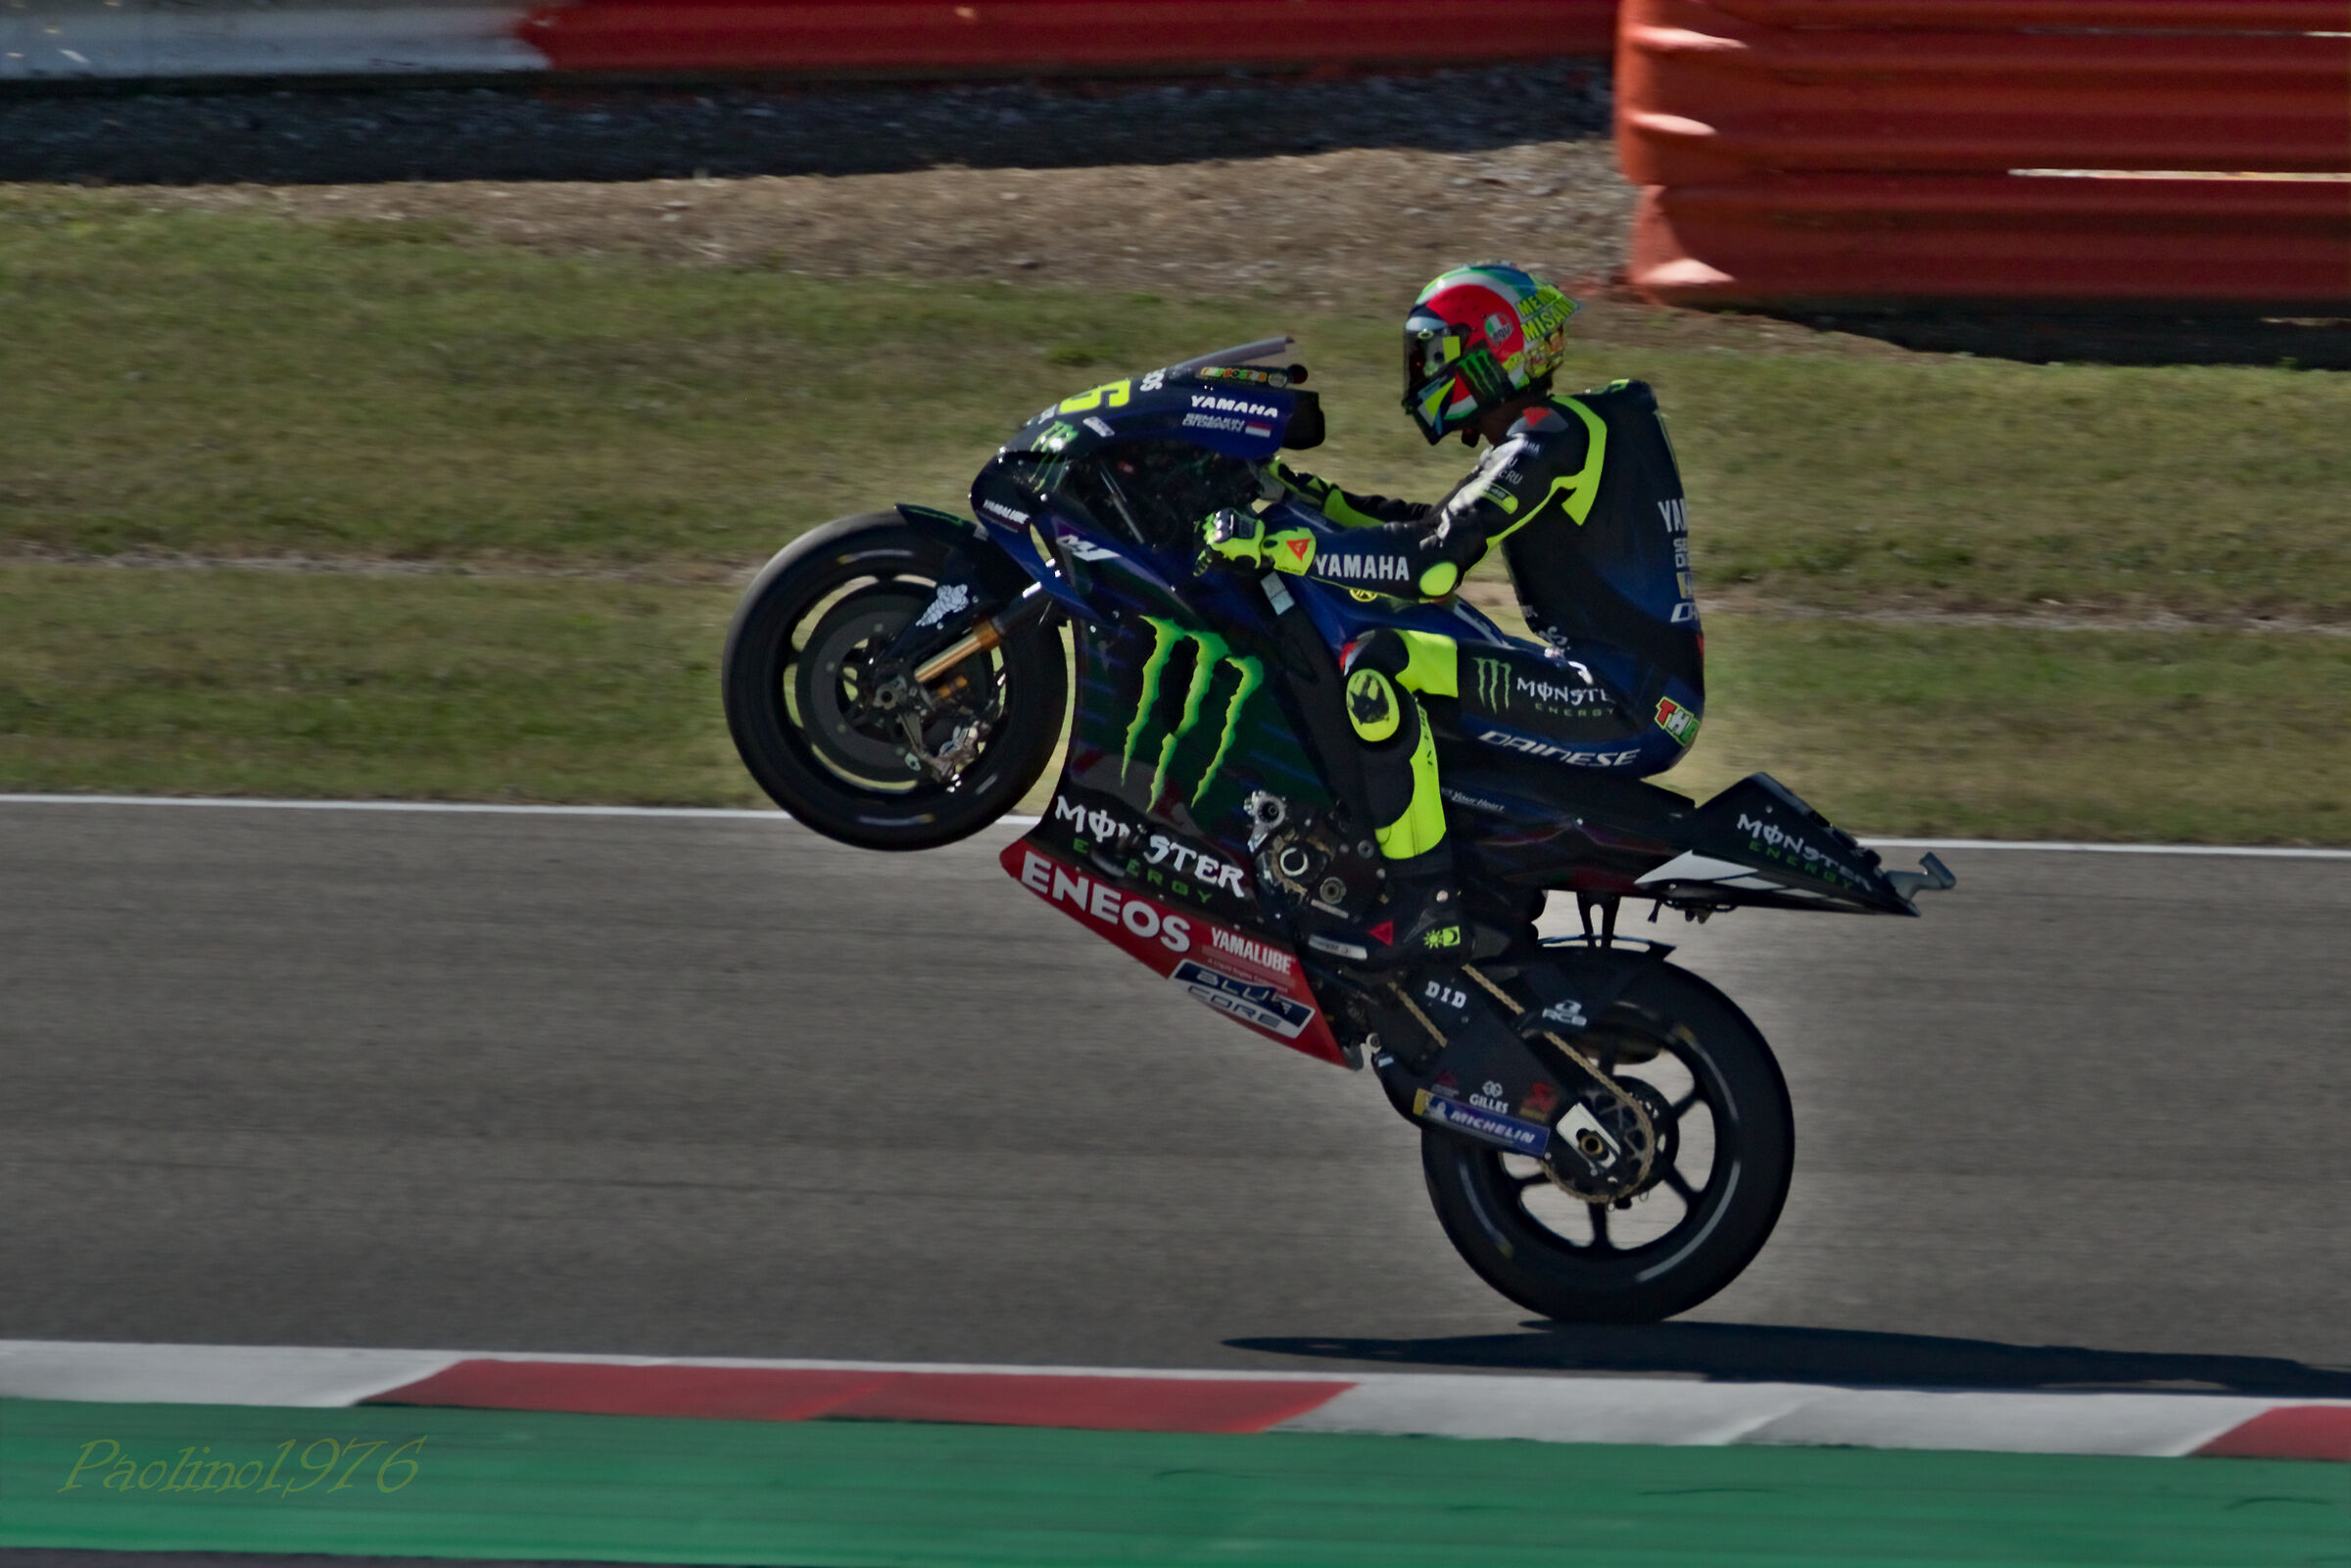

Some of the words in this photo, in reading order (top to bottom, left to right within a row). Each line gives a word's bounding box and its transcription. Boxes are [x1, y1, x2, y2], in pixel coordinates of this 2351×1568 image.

[1190, 395, 1278, 418] YAMAHA
[1314, 552, 1411, 582] YAMAHA
[1478, 730, 1642, 768] DAINESE
[1073, 836, 1213, 905] EERGY
[1748, 838, 1854, 890] ENERGY
[1021, 850, 1191, 953] ENEOS
[1211, 926, 1292, 975] YAMALUBE
[1468, 1092, 1510, 1116] GILLES
[1449, 1109, 1536, 1145] MICHELIN
